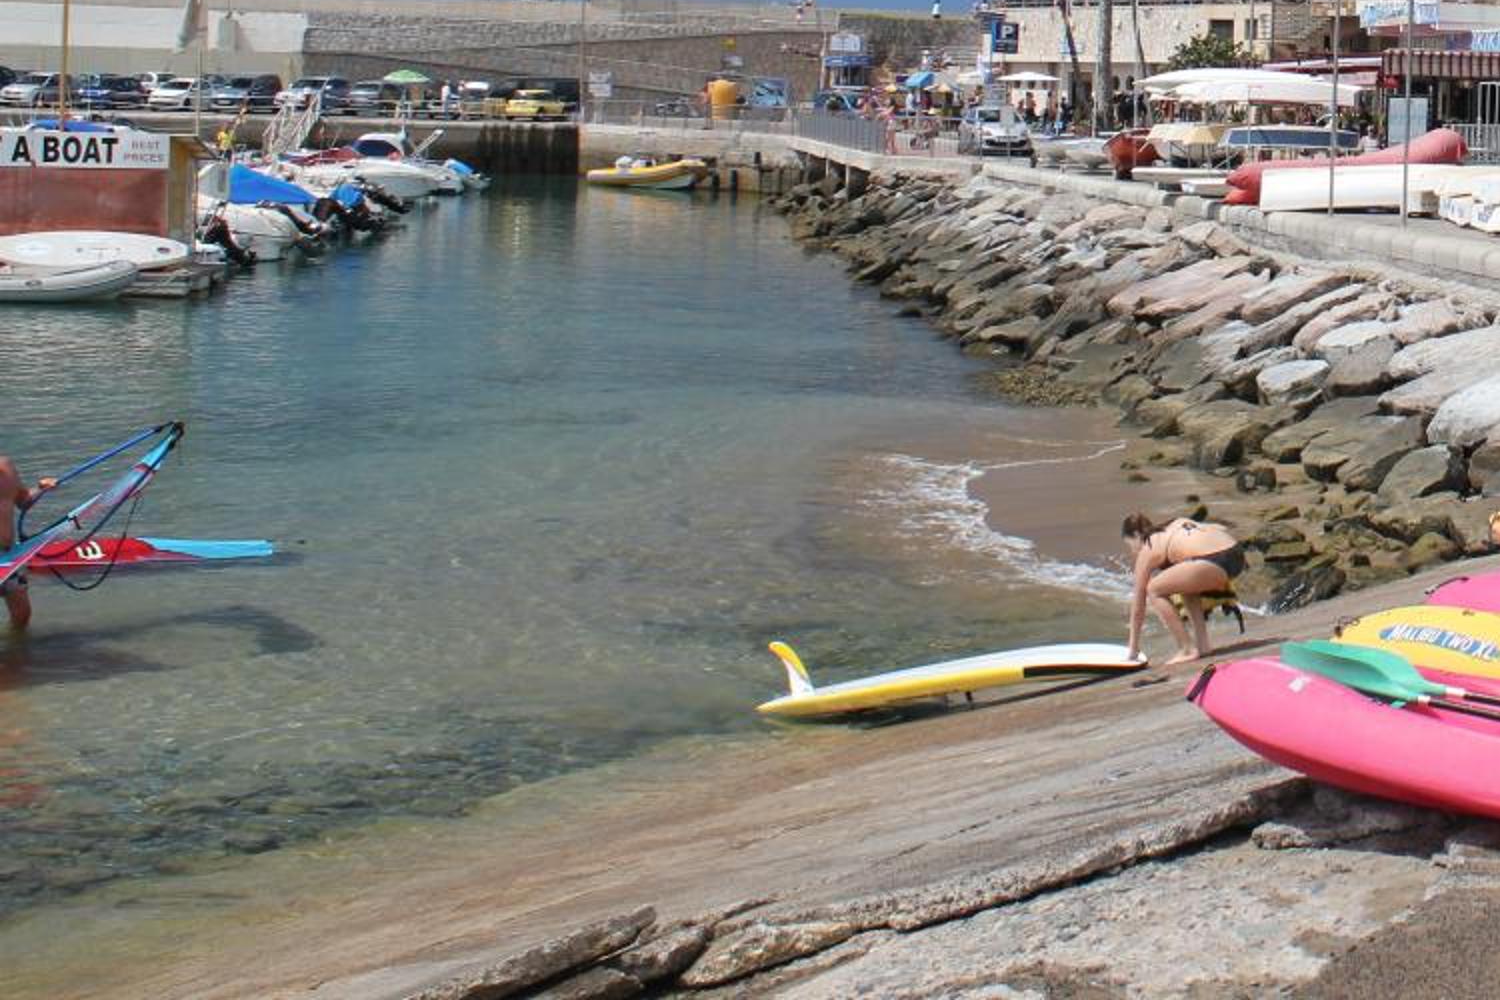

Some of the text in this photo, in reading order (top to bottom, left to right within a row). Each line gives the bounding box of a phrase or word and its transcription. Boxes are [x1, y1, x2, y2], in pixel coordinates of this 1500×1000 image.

[1001, 24, 1014, 39] P
[11, 135, 119, 164] A BOAT
[1386, 621, 1441, 645] MALIBU
